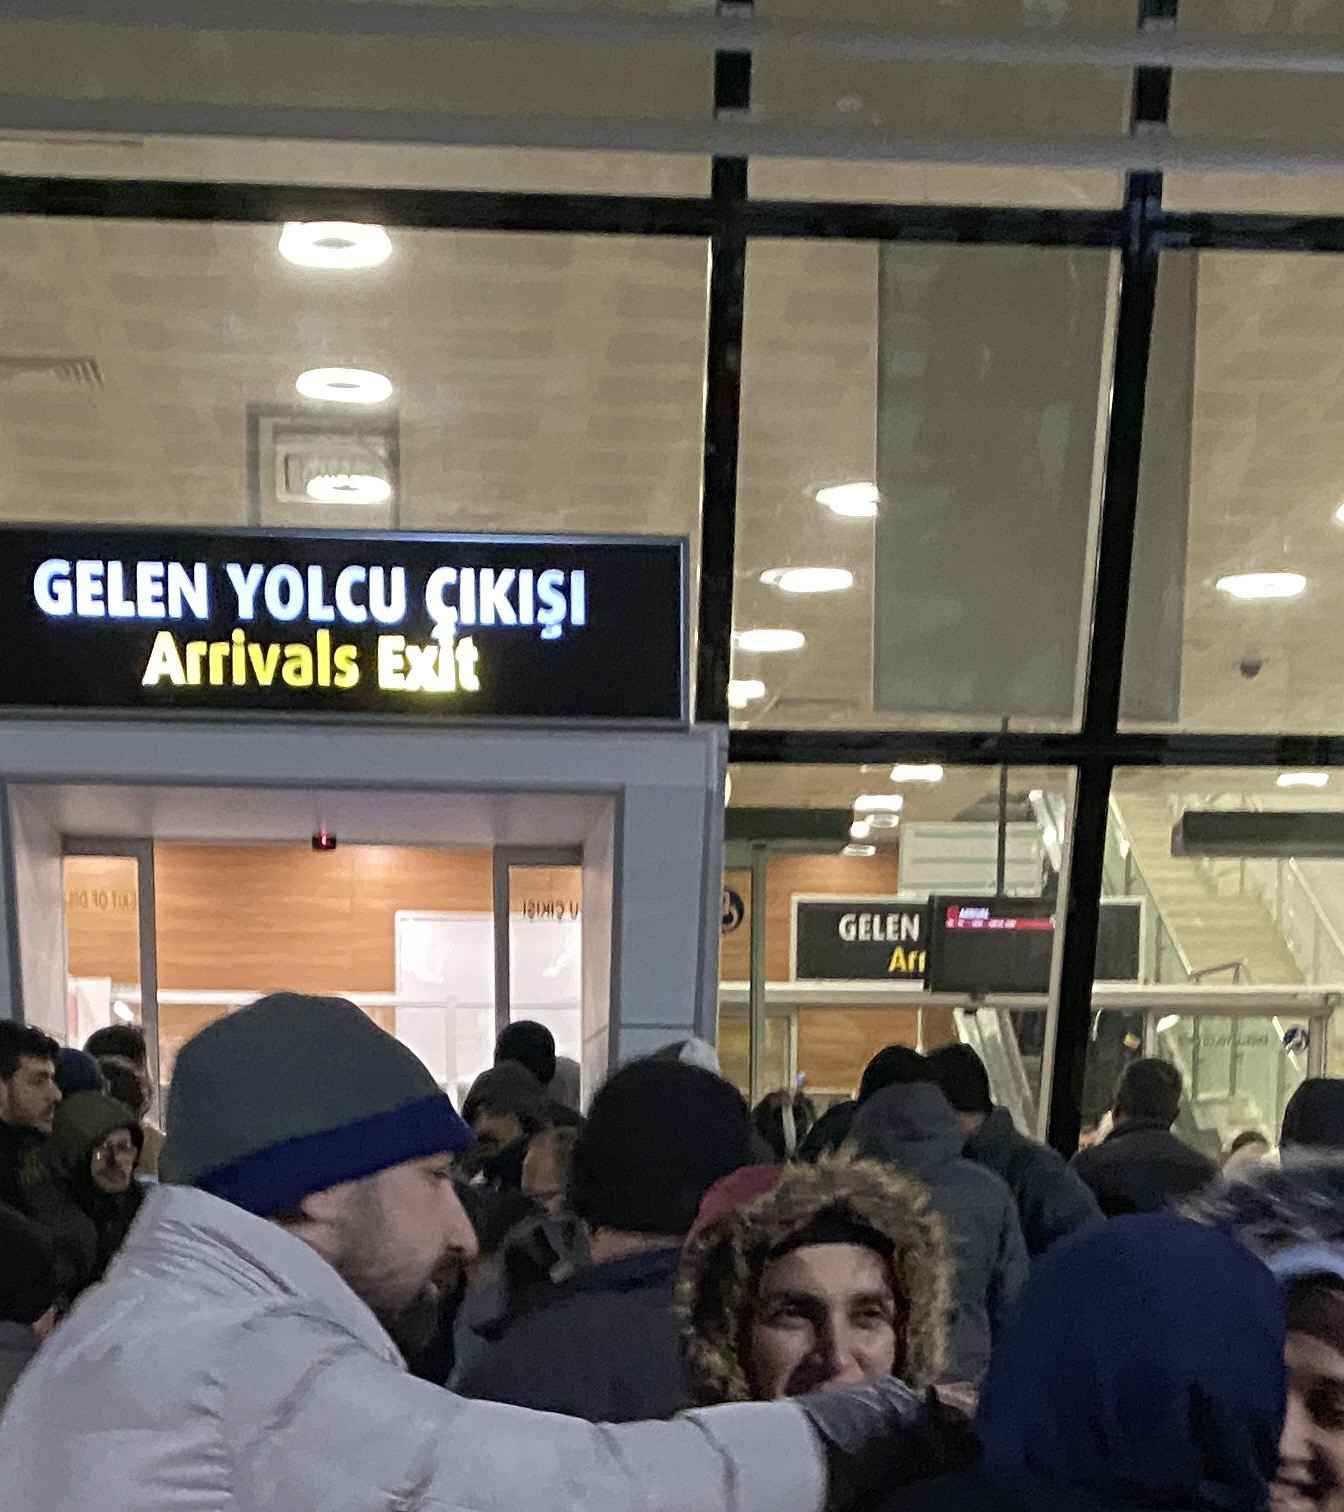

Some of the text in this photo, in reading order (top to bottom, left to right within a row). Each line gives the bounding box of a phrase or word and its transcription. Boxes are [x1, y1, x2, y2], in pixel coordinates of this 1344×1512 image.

[33, 558, 586, 640] GELEN YOLCU ÇIKIŞI
[142, 628, 480, 692] Arrivals Exit
[838, 912, 920, 942] GELEN
